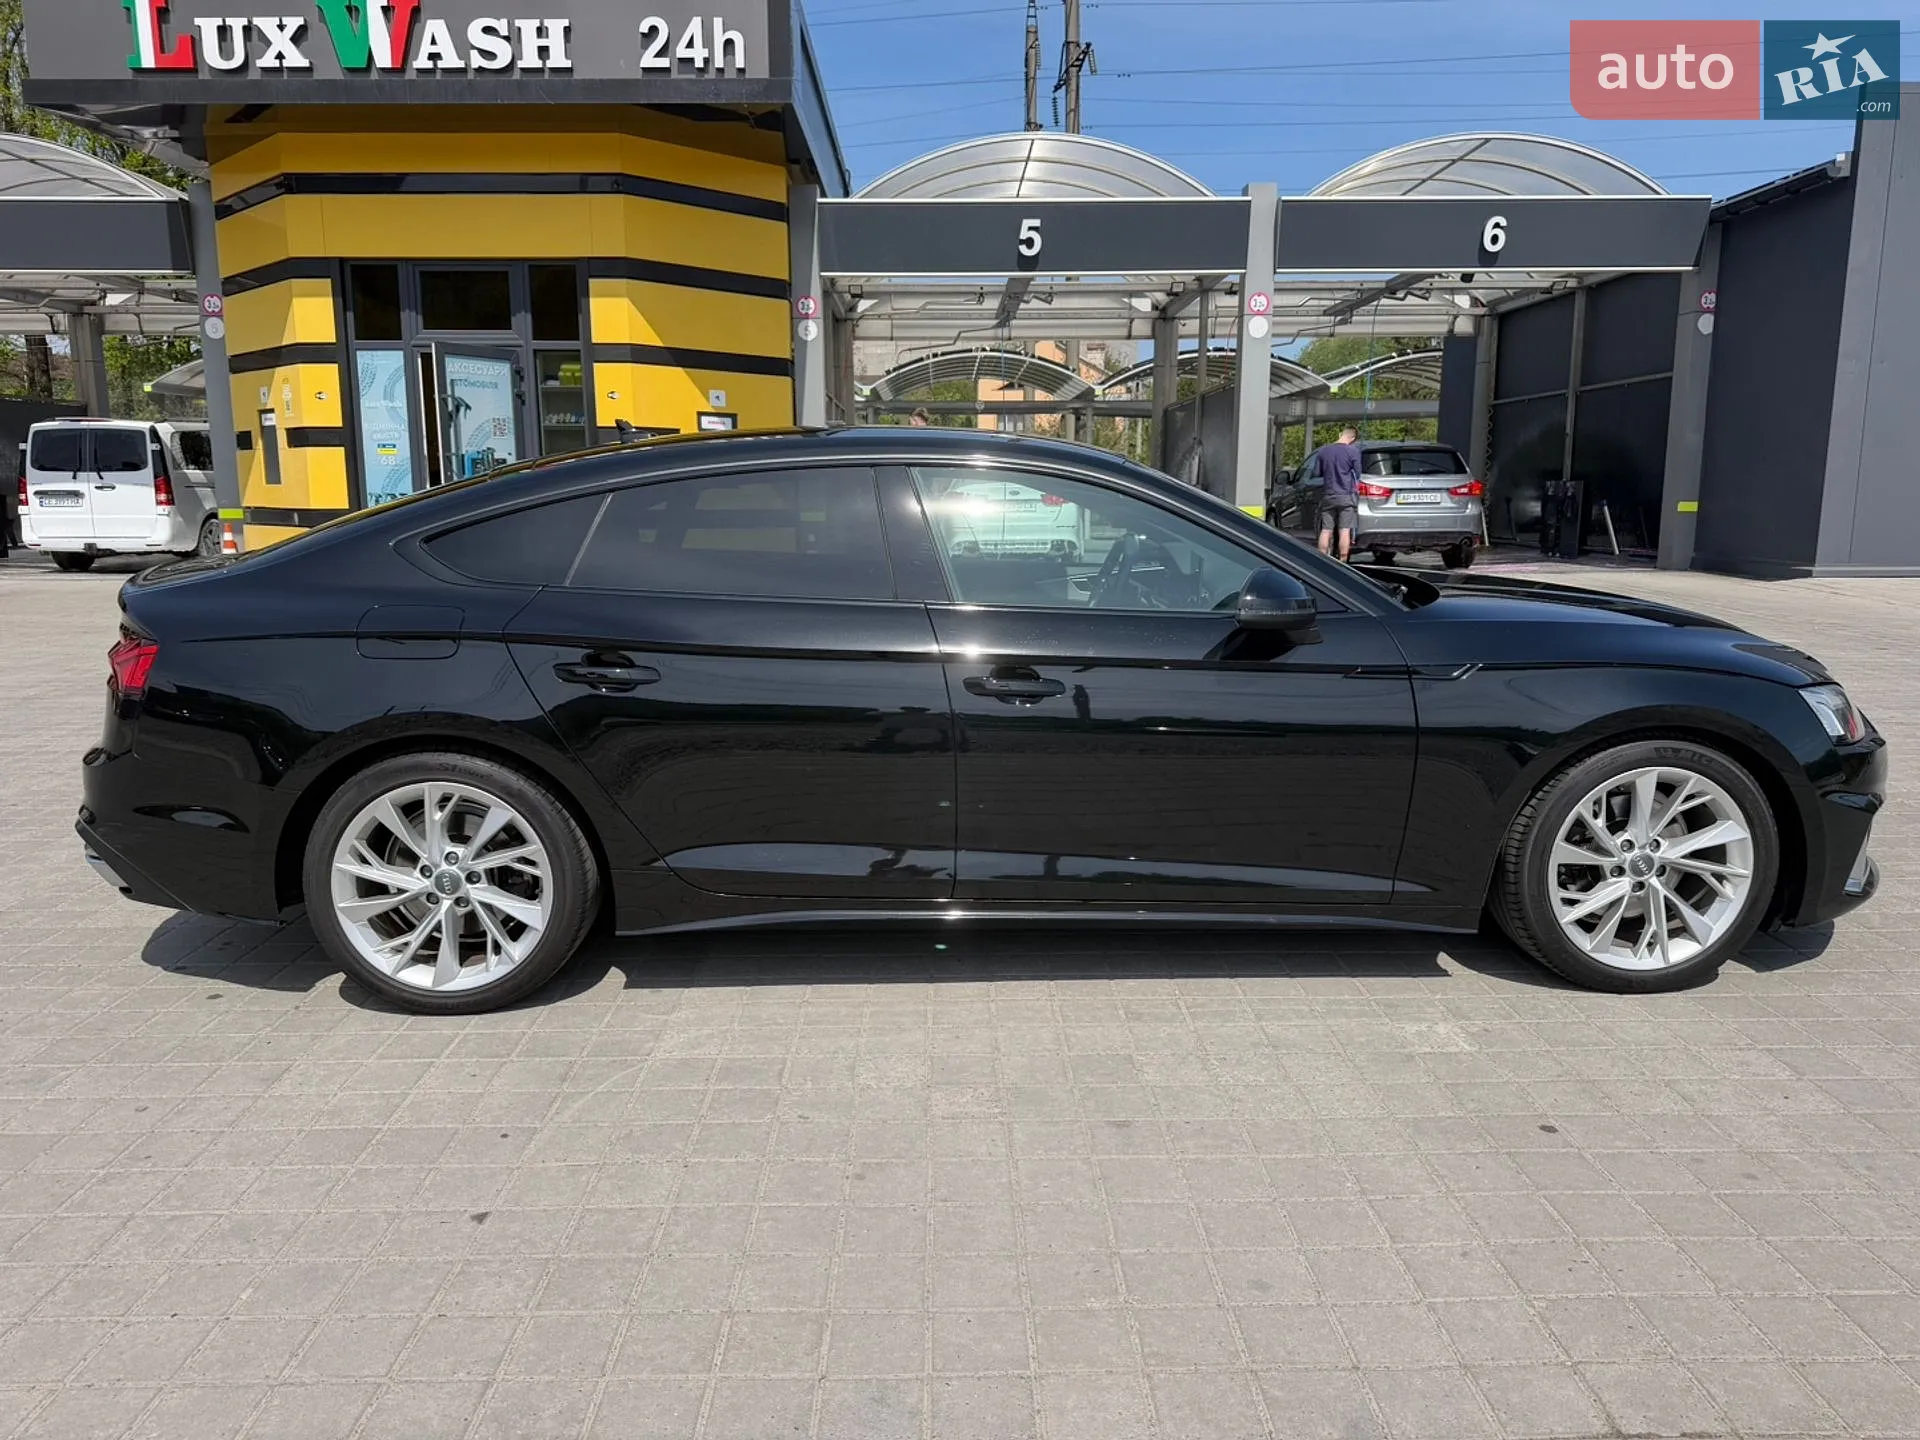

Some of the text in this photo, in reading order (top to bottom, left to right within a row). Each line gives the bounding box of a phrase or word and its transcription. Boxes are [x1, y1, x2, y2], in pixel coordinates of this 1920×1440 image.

[639, 16, 746, 69] 24h
[1018, 218, 1042, 256] 5
[1483, 215, 1507, 252] 6
